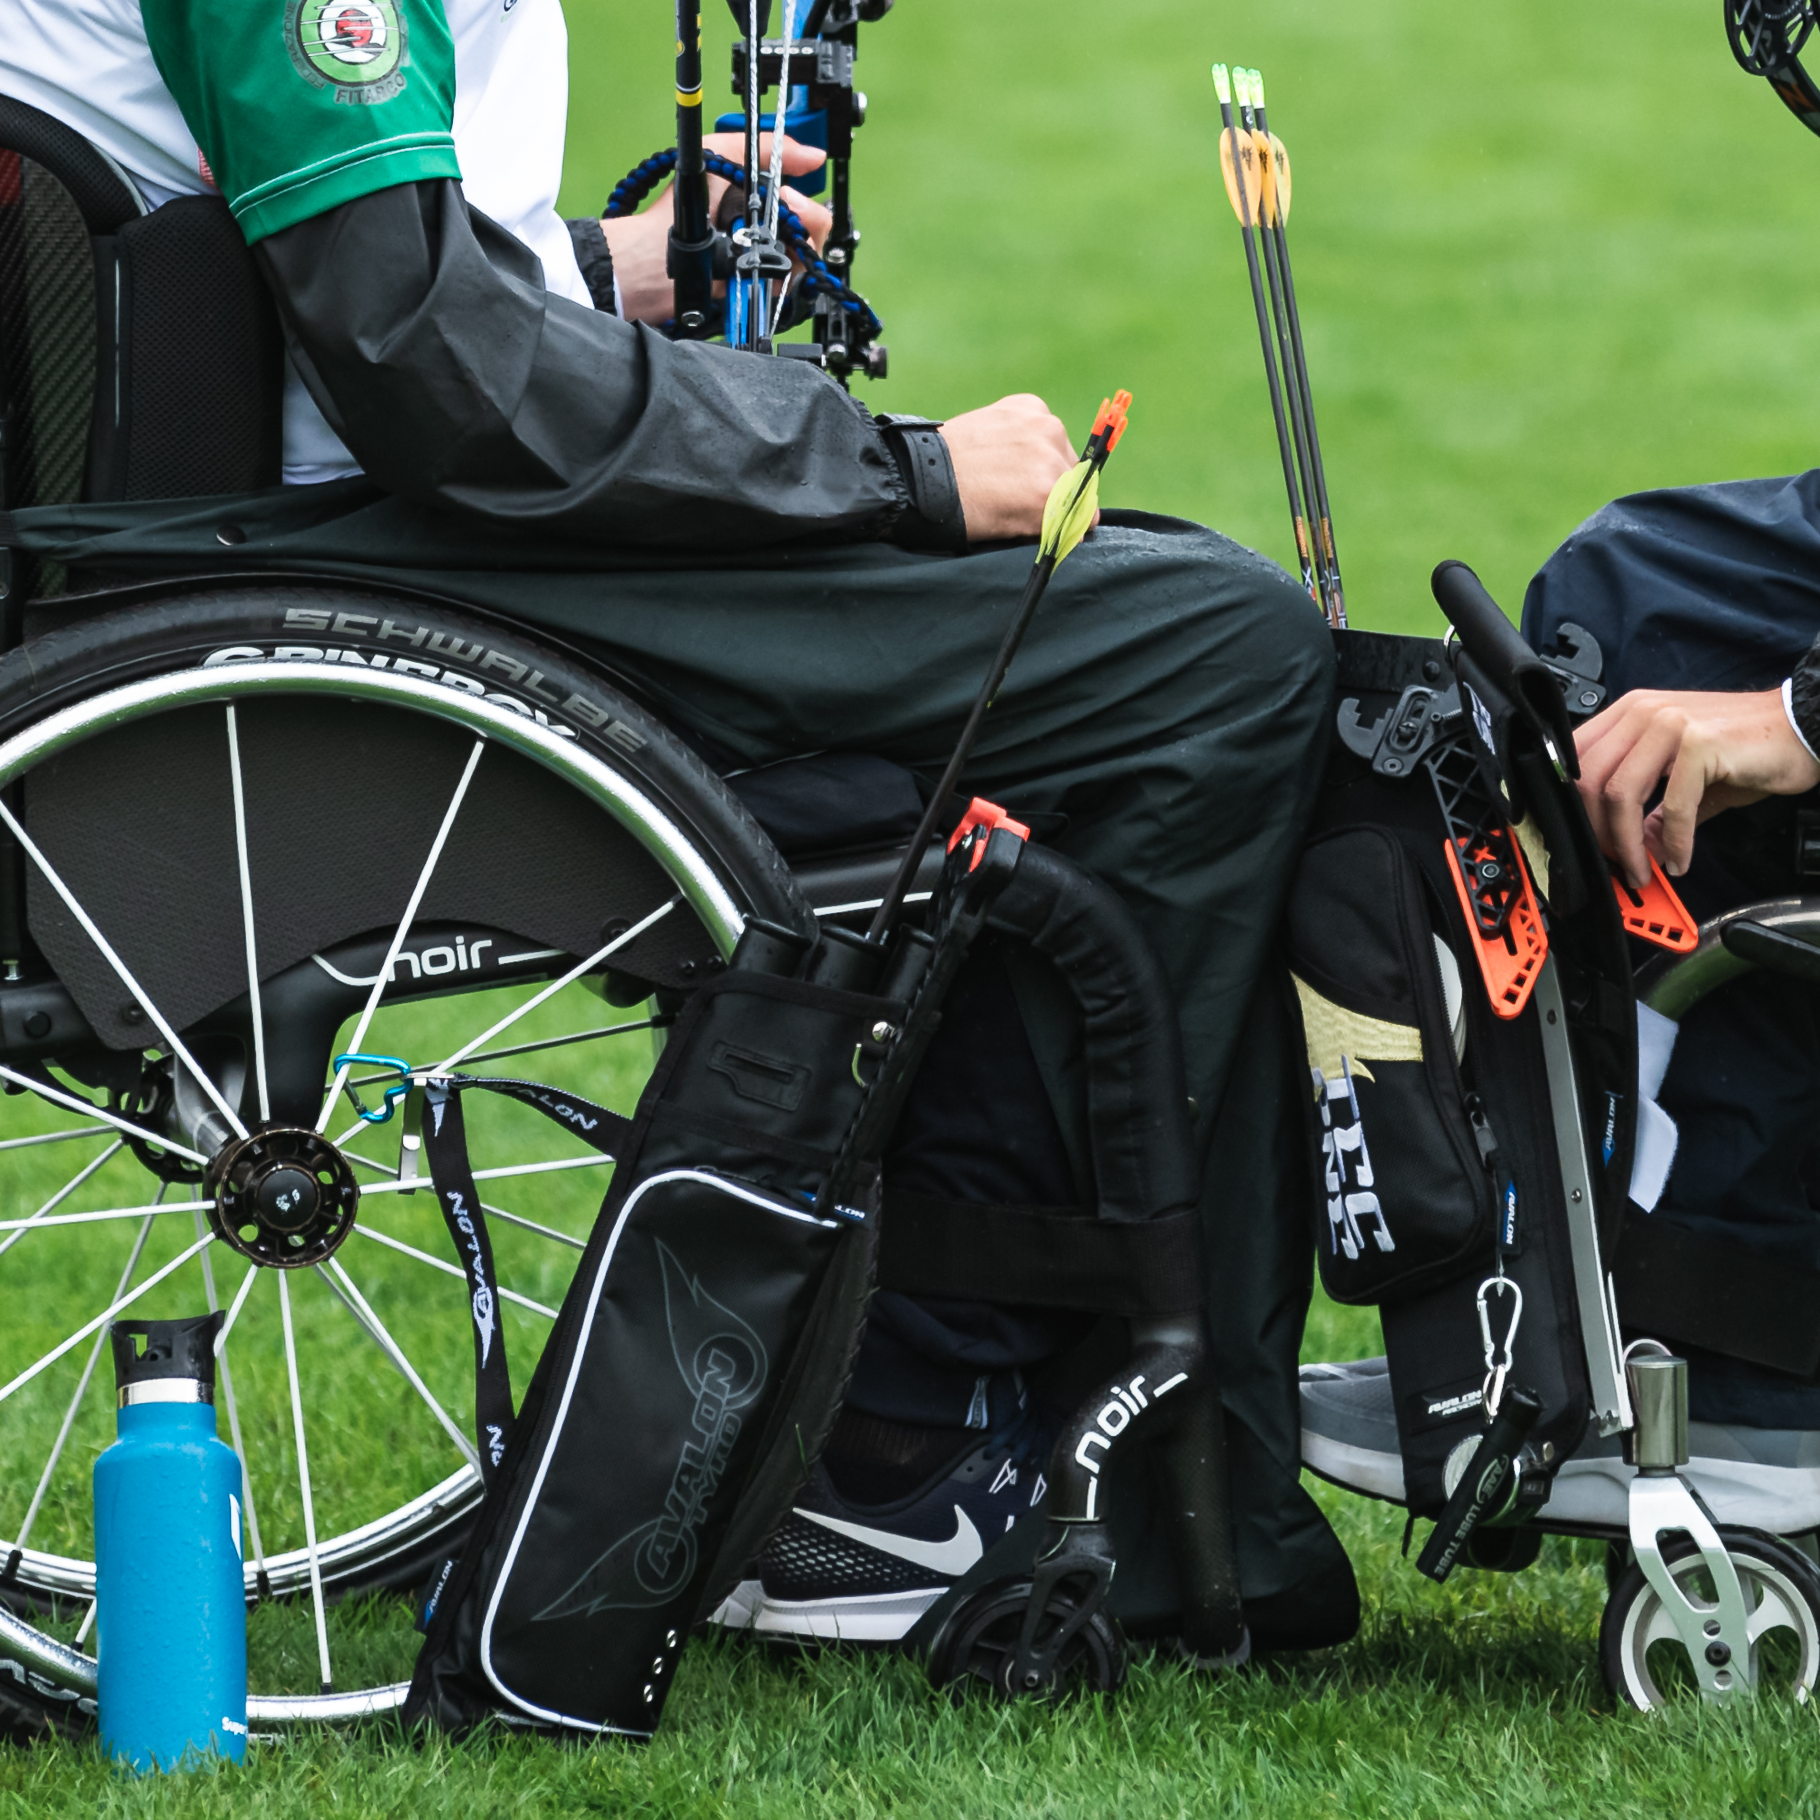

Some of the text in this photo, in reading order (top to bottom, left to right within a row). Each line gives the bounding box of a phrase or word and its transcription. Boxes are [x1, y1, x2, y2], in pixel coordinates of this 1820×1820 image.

[336, 73, 406, 104] FITARCO
[282, 607, 647, 753] SCHWALBE
[386, 935, 493, 982] noir
[1505, 1191, 1515, 1245] AVALON
[1075, 1374, 1150, 1475] noir
[1428, 1390, 1482, 1414] AVALON
[647, 1348, 736, 1579] AVALON
[683, 1411, 742, 1528] TYRO
[1482, 1463, 1507, 1499] AAE
[1434, 1503, 1480, 1577] LUBE TUBE
[429, 1560, 453, 1613] AVALON
